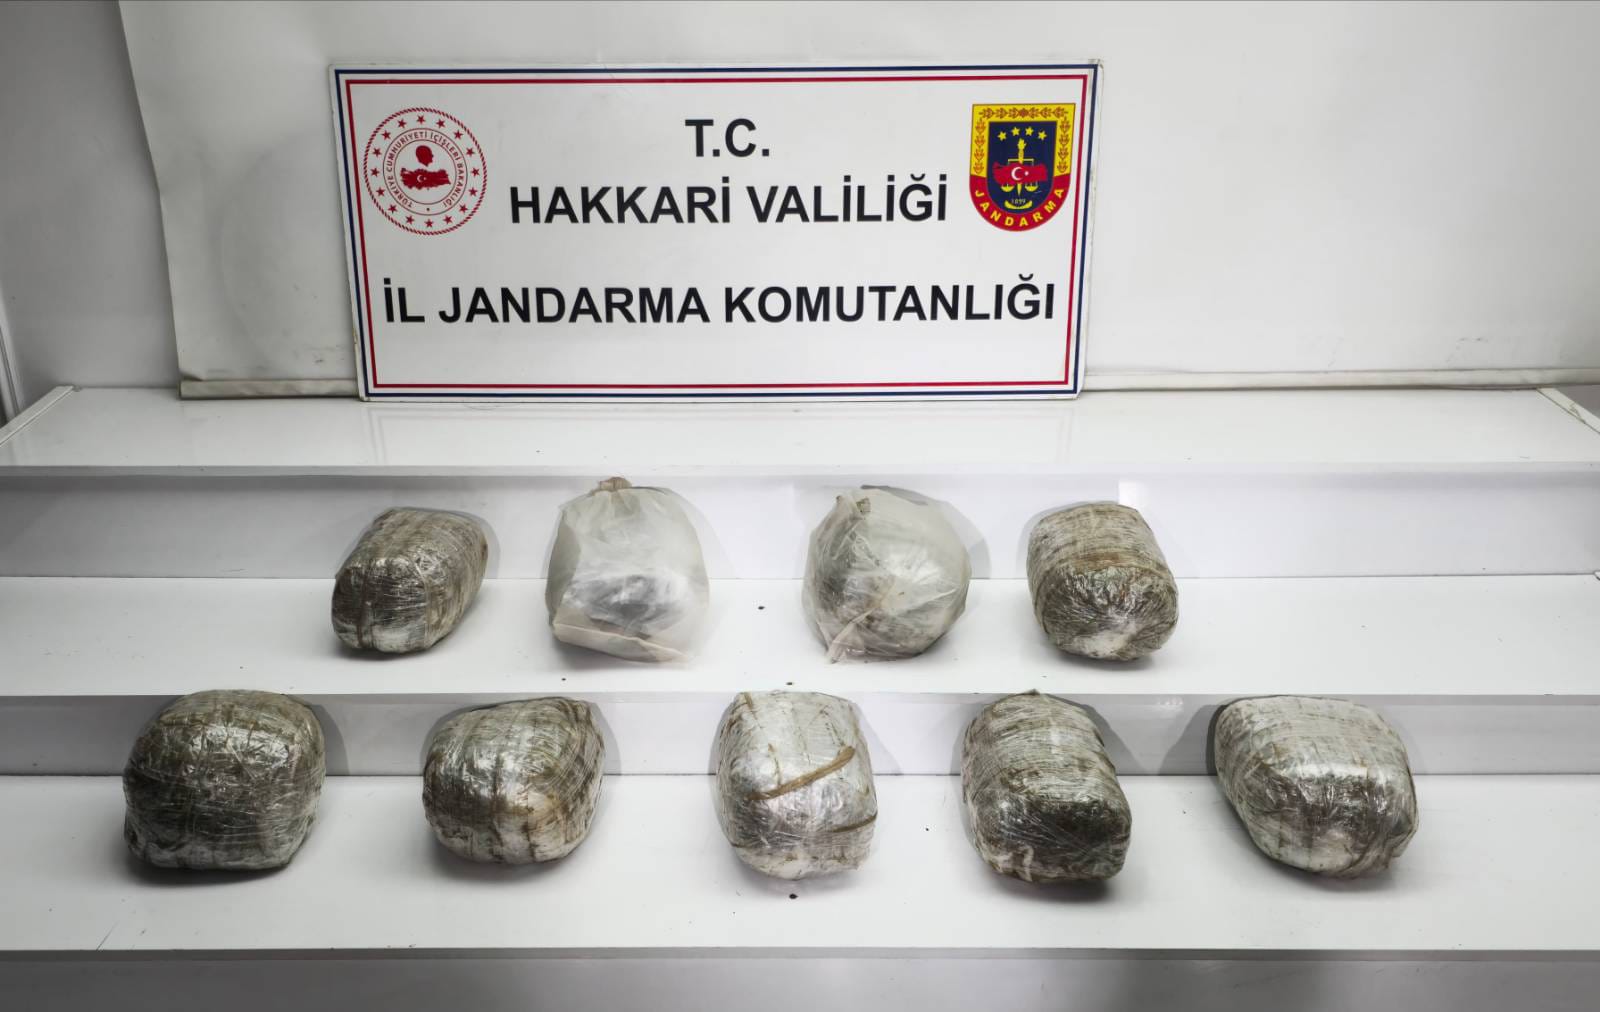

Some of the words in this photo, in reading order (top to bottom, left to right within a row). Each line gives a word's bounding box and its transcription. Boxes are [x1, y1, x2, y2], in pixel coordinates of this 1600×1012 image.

[386, 131, 428, 172] CUMHURİYETİ
[430, 132, 460, 161] İÇİŞLERİ
[685, 118, 769, 158] T.C.
[387, 175, 413, 208] TÜRKİYE
[443, 163, 465, 208] BAKANLIĞI
[510, 176, 730, 224] HAKKARİ
[746, 173, 947, 223] VALİLİĞİ
[975, 188, 1064, 227] JANDARMA
[384, 277, 426, 323] İL
[438, 286, 711, 324] JANDARMA
[725, 273, 1055, 323] KOMUTANLIĞI
